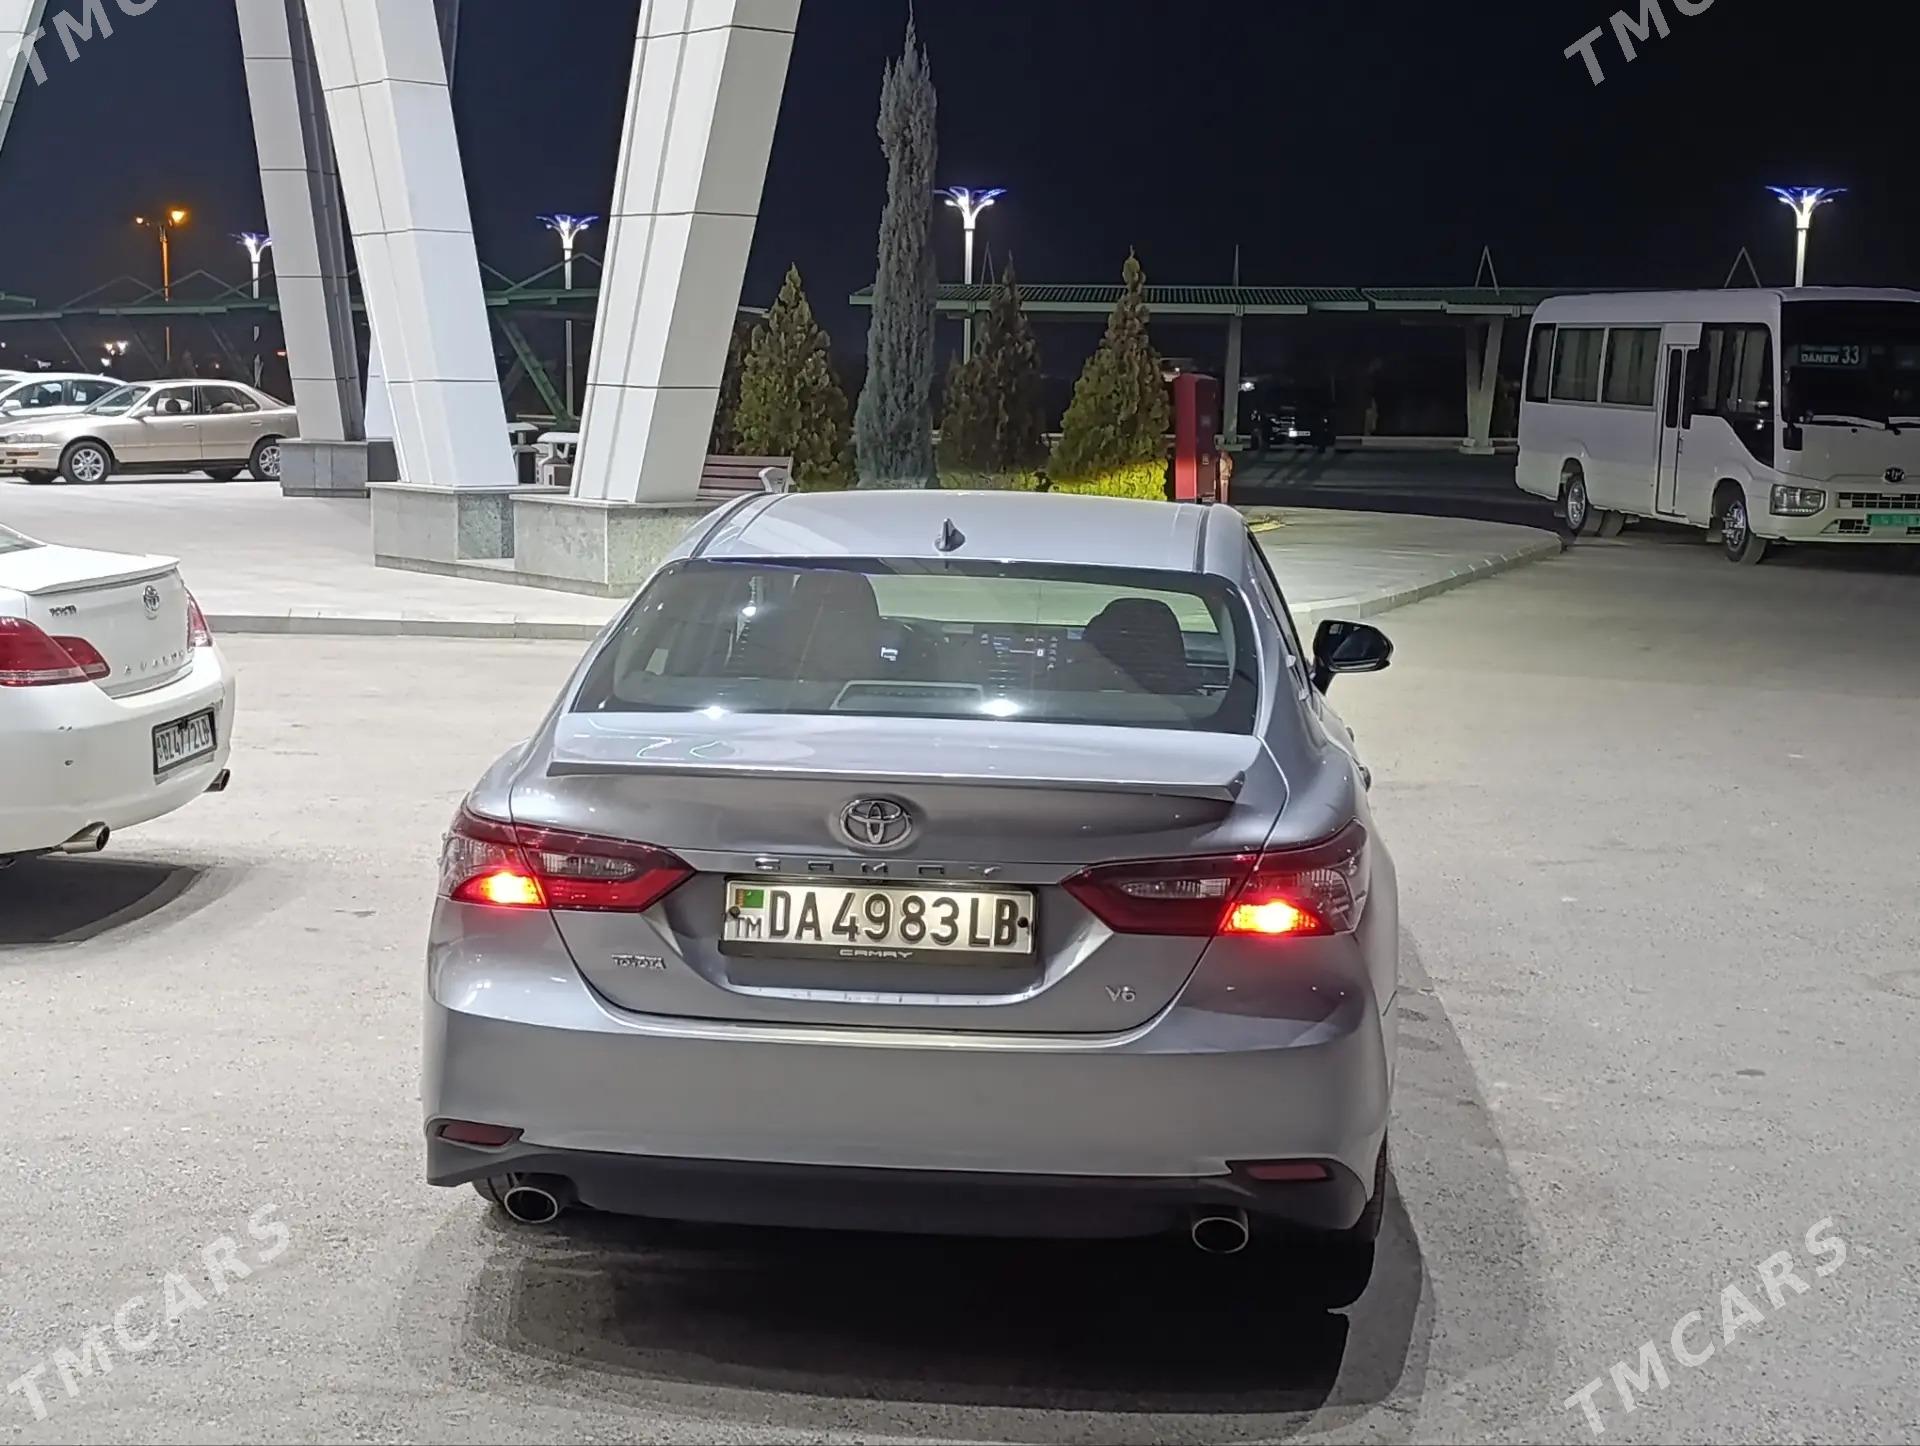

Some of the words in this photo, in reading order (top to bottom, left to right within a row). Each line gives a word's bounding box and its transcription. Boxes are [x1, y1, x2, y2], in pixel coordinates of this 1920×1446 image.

[1841, 345, 1860, 364] 33
[769, 890, 1020, 948] DA4983LB
[839, 949, 913, 959] CAMRY
[1105, 985, 1136, 1003] V6
